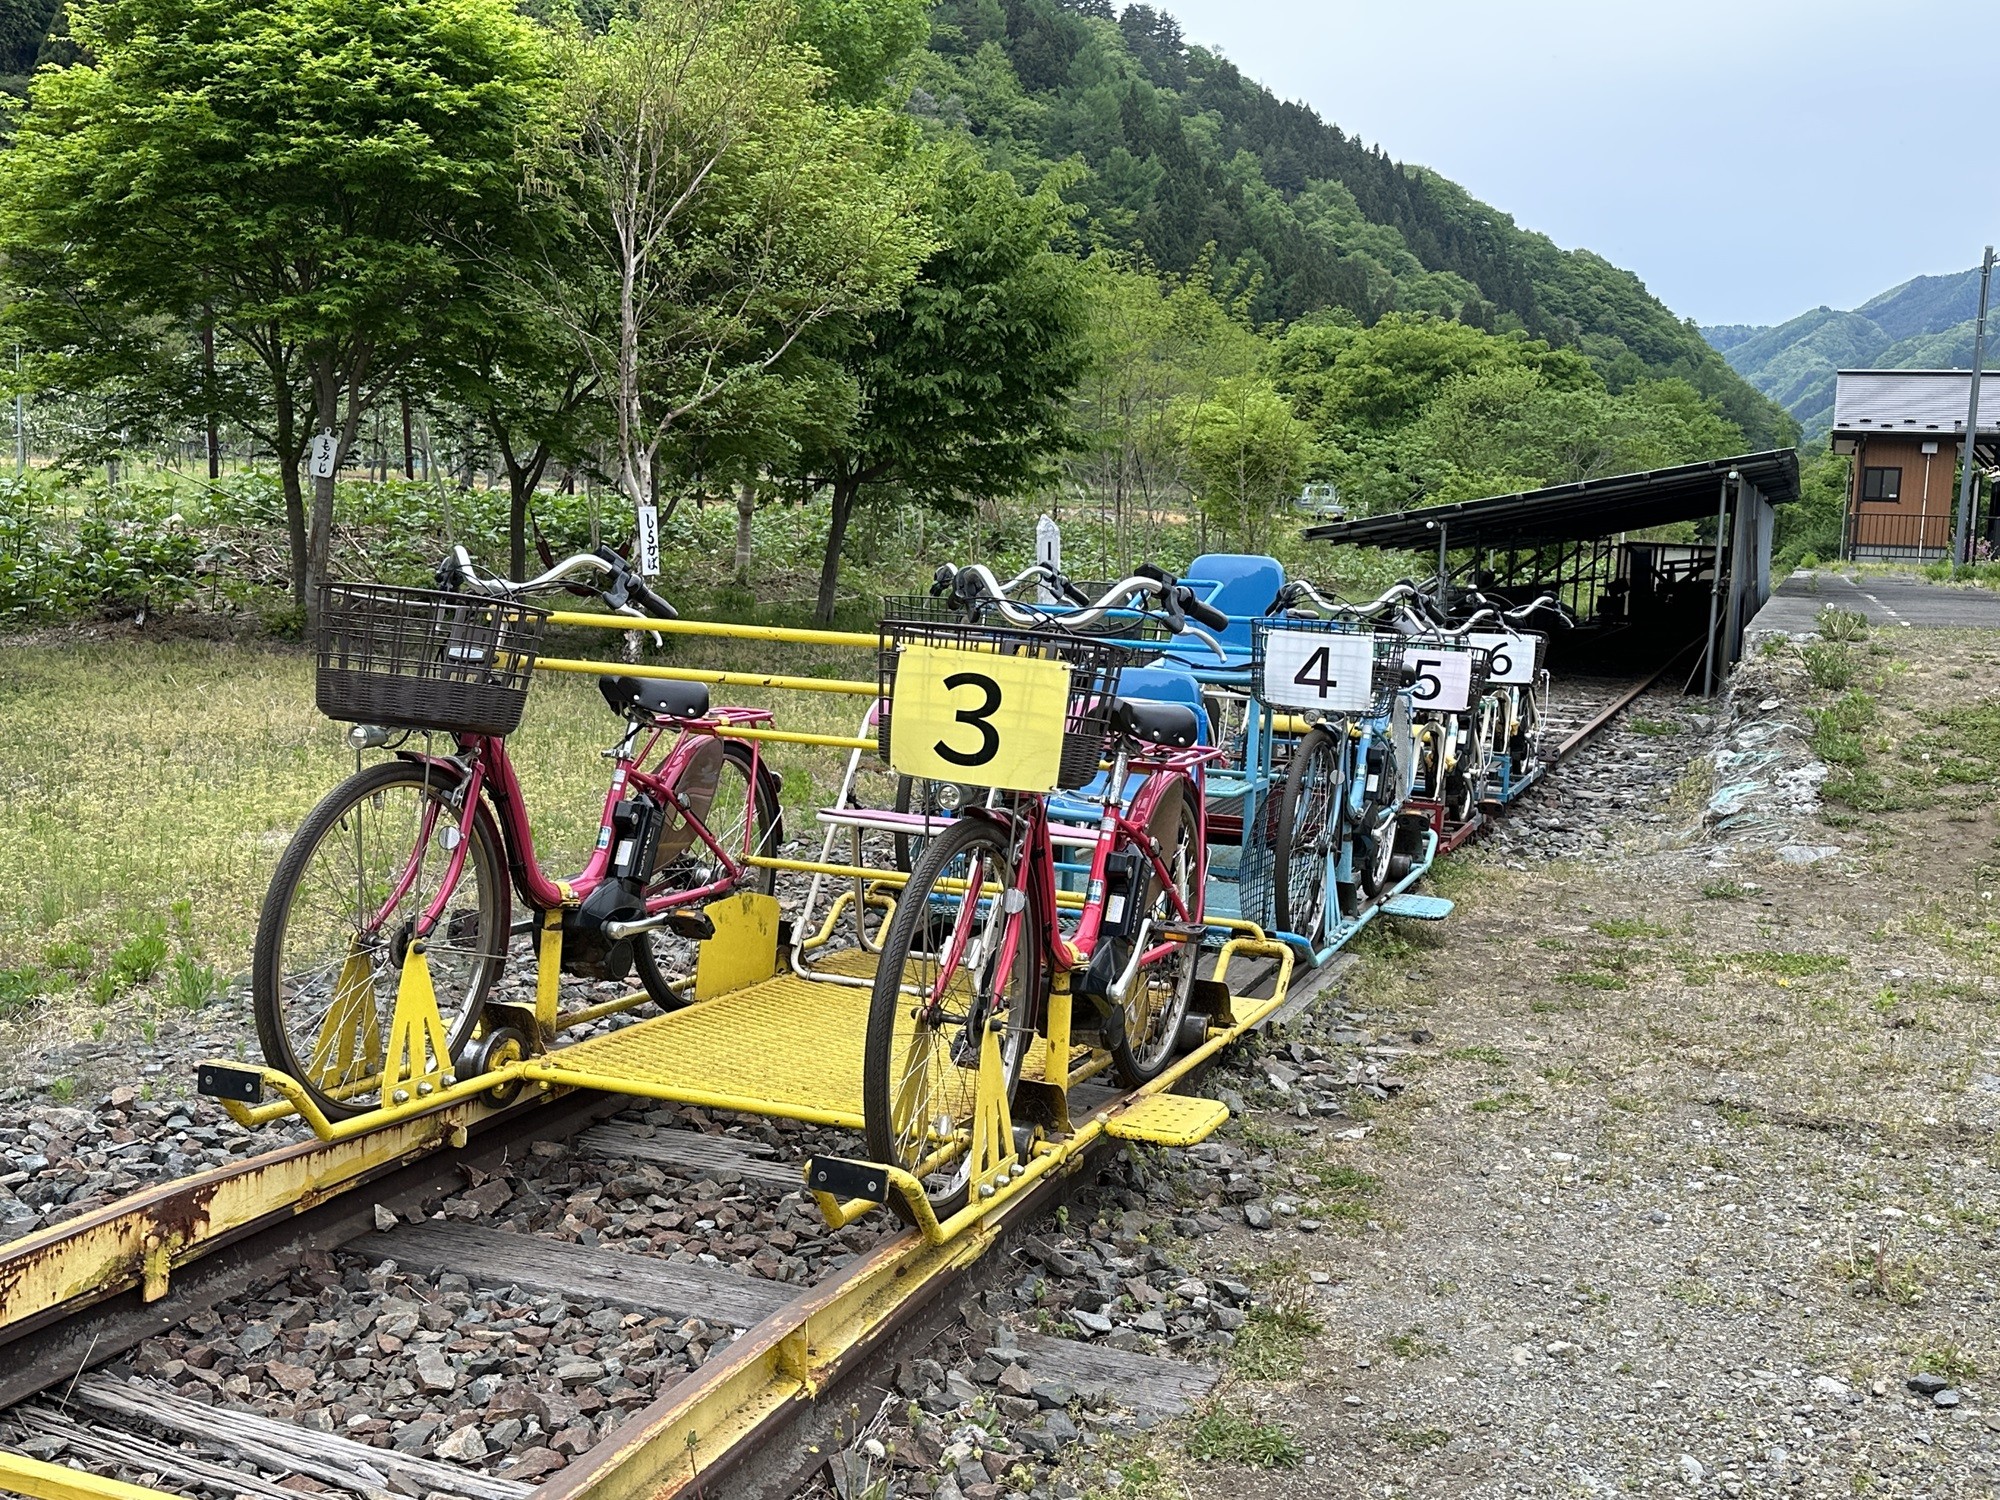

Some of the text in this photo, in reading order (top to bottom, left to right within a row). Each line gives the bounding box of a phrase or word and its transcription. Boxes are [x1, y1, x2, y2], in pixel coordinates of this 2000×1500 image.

[317, 438, 331, 474] もみじ
[645, 513, 659, 571] しらかば
[1294, 646, 1338, 699] 4
[1412, 659, 1442, 701] 5
[1491, 641, 1513, 676] 6
[933, 672, 1003, 767] 3
